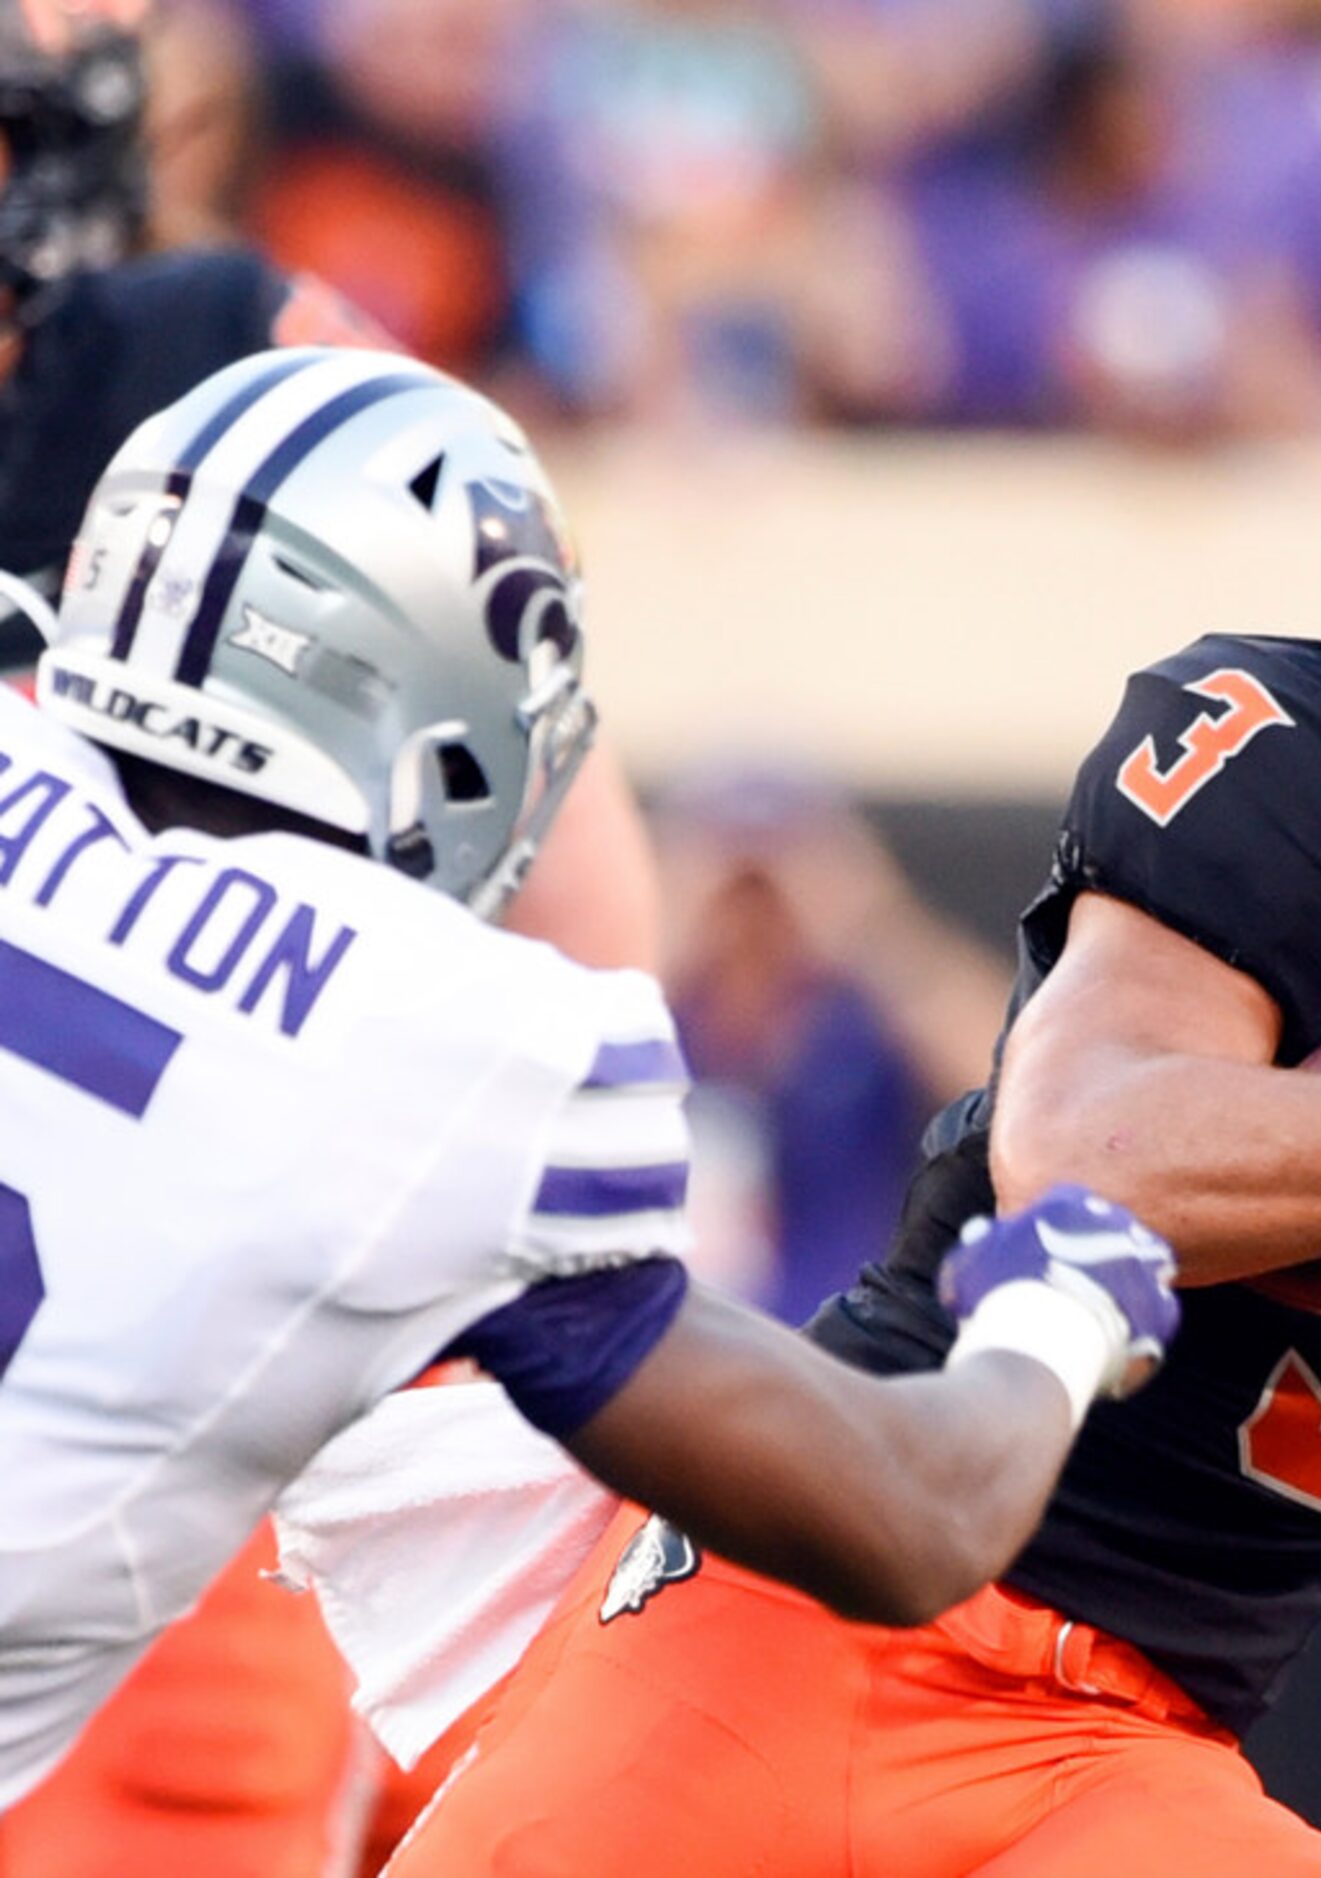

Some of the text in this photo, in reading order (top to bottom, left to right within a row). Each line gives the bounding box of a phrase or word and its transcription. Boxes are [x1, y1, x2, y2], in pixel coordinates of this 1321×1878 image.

[53, 667, 275, 776] WILDCATS
[1116, 669, 1296, 827] 3
[0, 752, 358, 1039] ATTON
